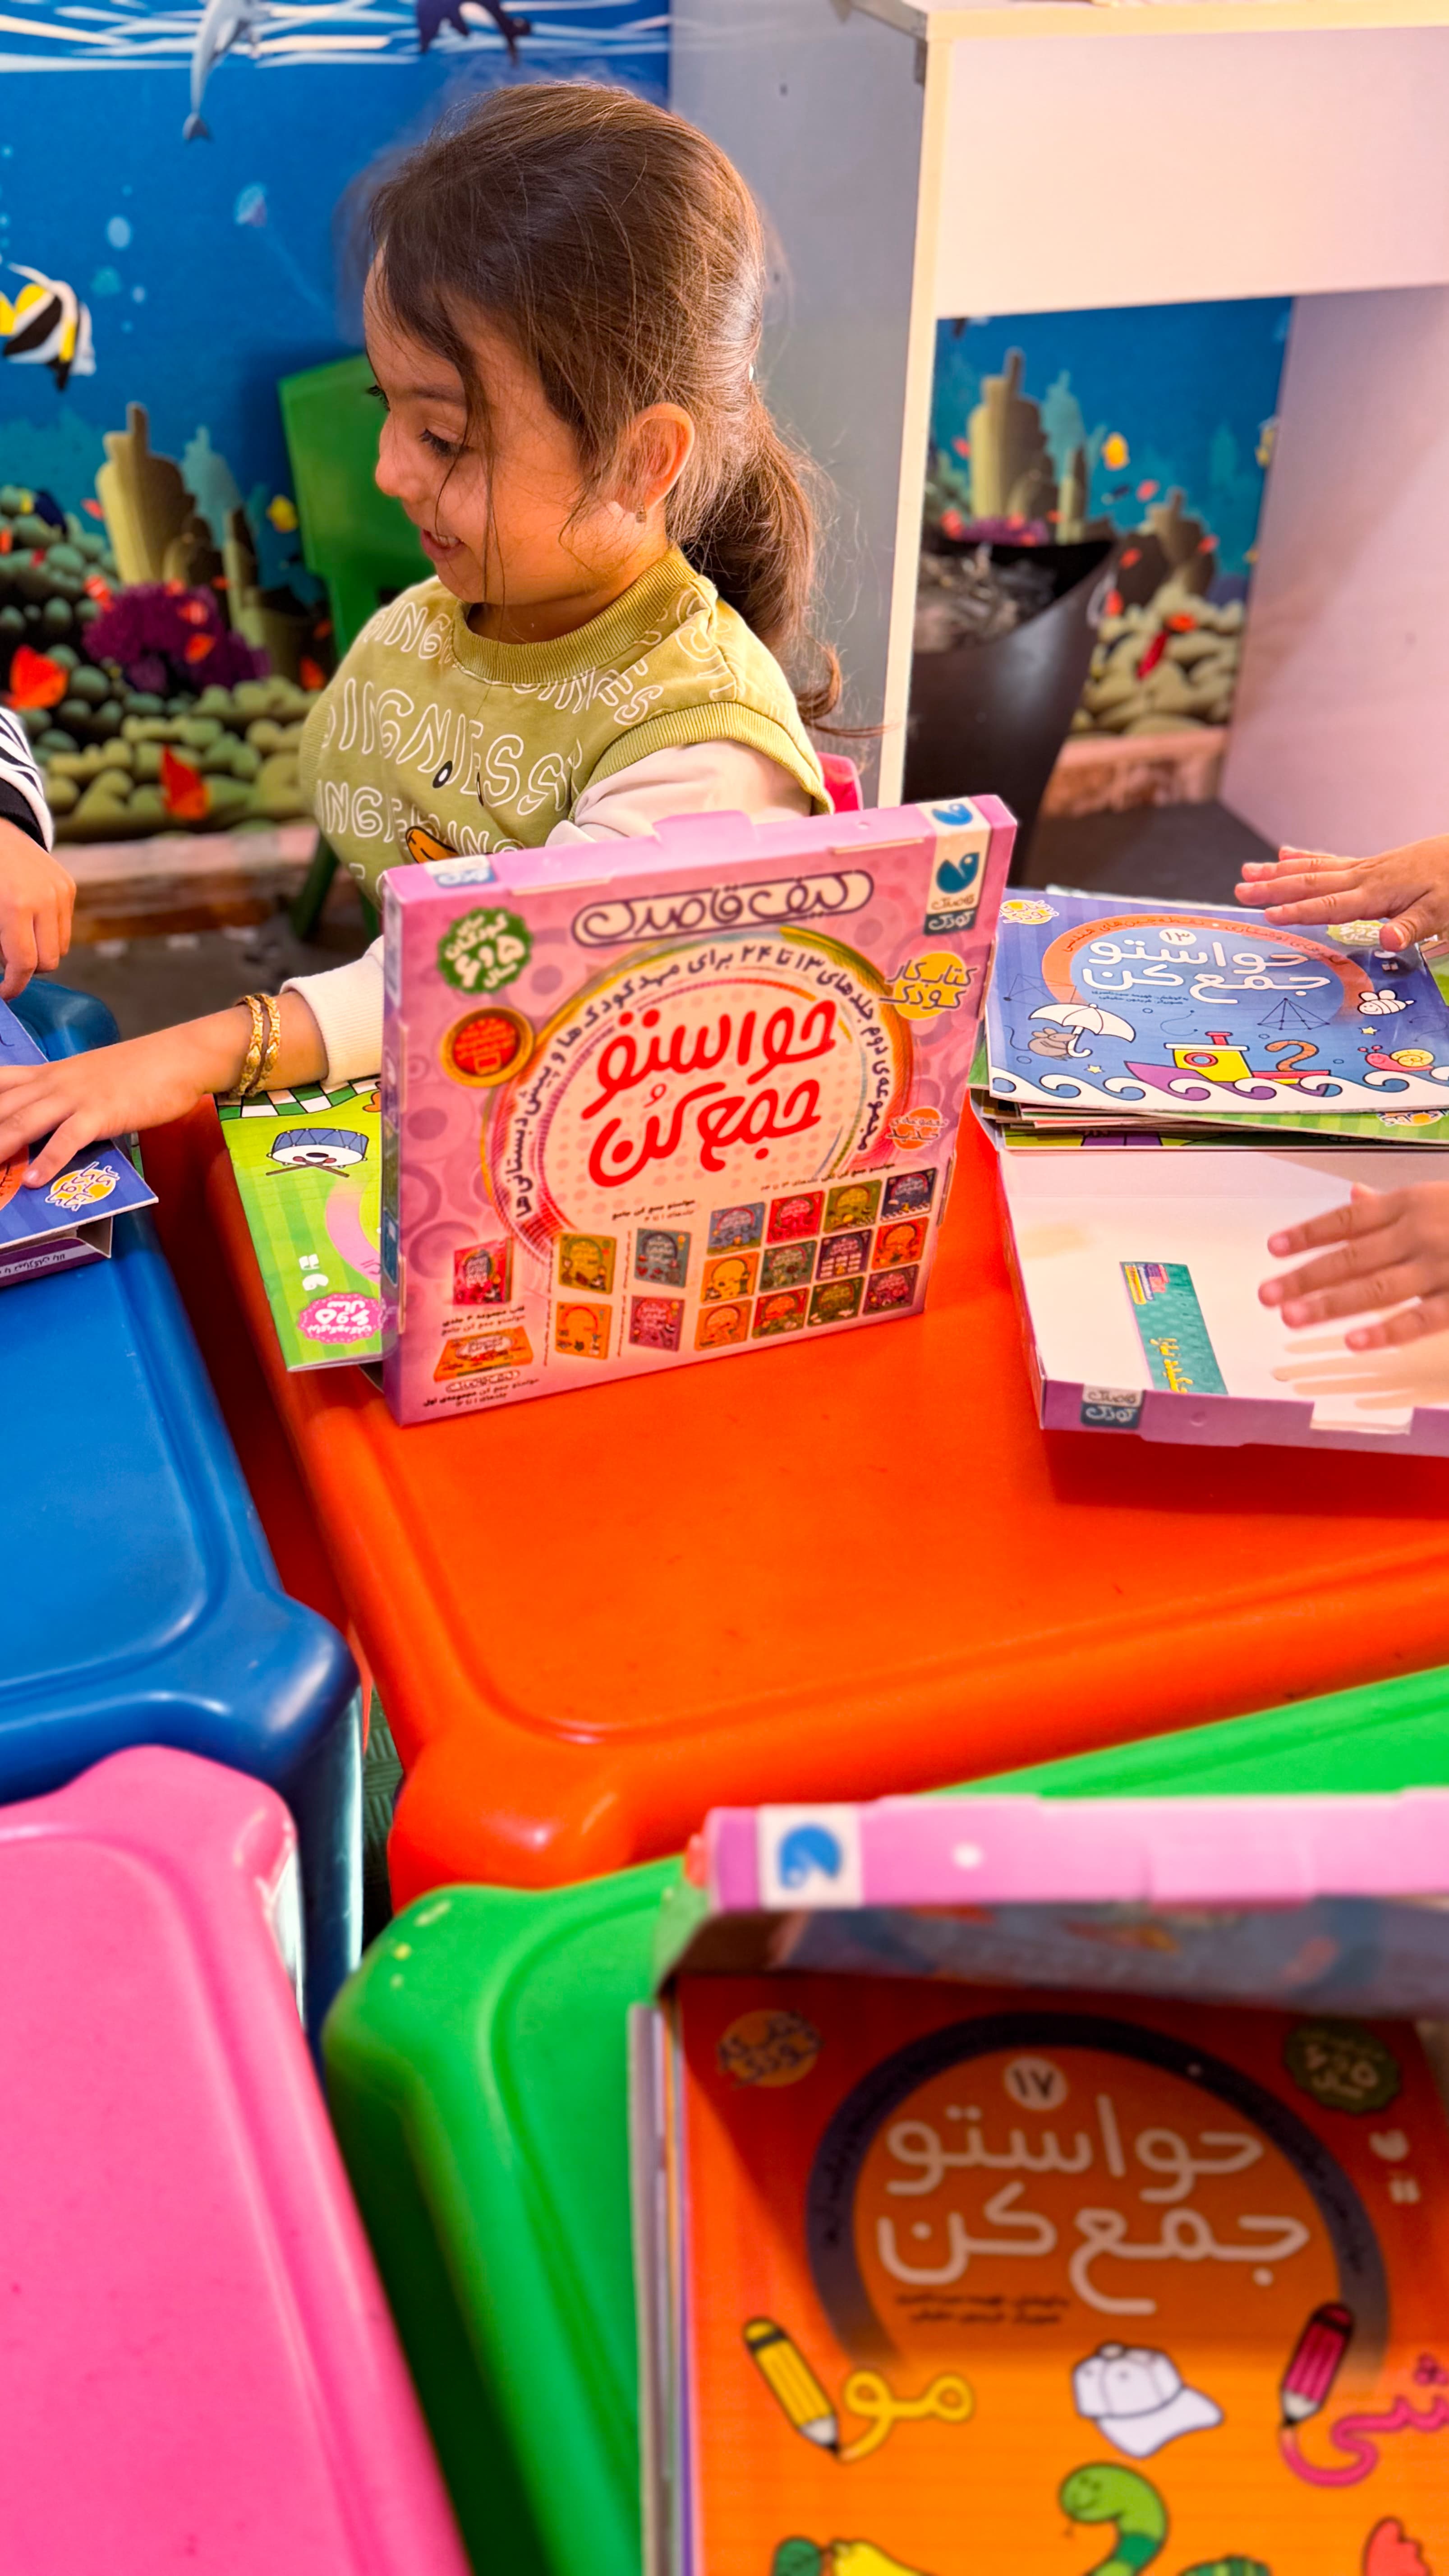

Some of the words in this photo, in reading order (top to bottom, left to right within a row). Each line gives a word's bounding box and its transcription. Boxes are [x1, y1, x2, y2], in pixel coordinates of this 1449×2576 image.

[1165, 931, 1191, 942] ۱۳
[687, 949, 734, 973] برای
[776, 948, 791, 965] تا
[1088, 939, 1309, 975] حواستو
[1082, 963, 1184, 991] کن
[1189, 974, 1331, 1005] جمع
[879, 984, 966, 1011] کودک
[860, 1025, 888, 1056] دوم
[581, 1000, 837, 1121] حواستو
[697, 1079, 821, 1173] جمع
[314, 1308, 337, 1324] ۵
[1012, 2068, 1057, 2100] ۱۷
[883, 2093, 1265, 2205] حواستو
[875, 2179, 1059, 2287] کن
[1067, 2205, 1310, 2316] جمع
